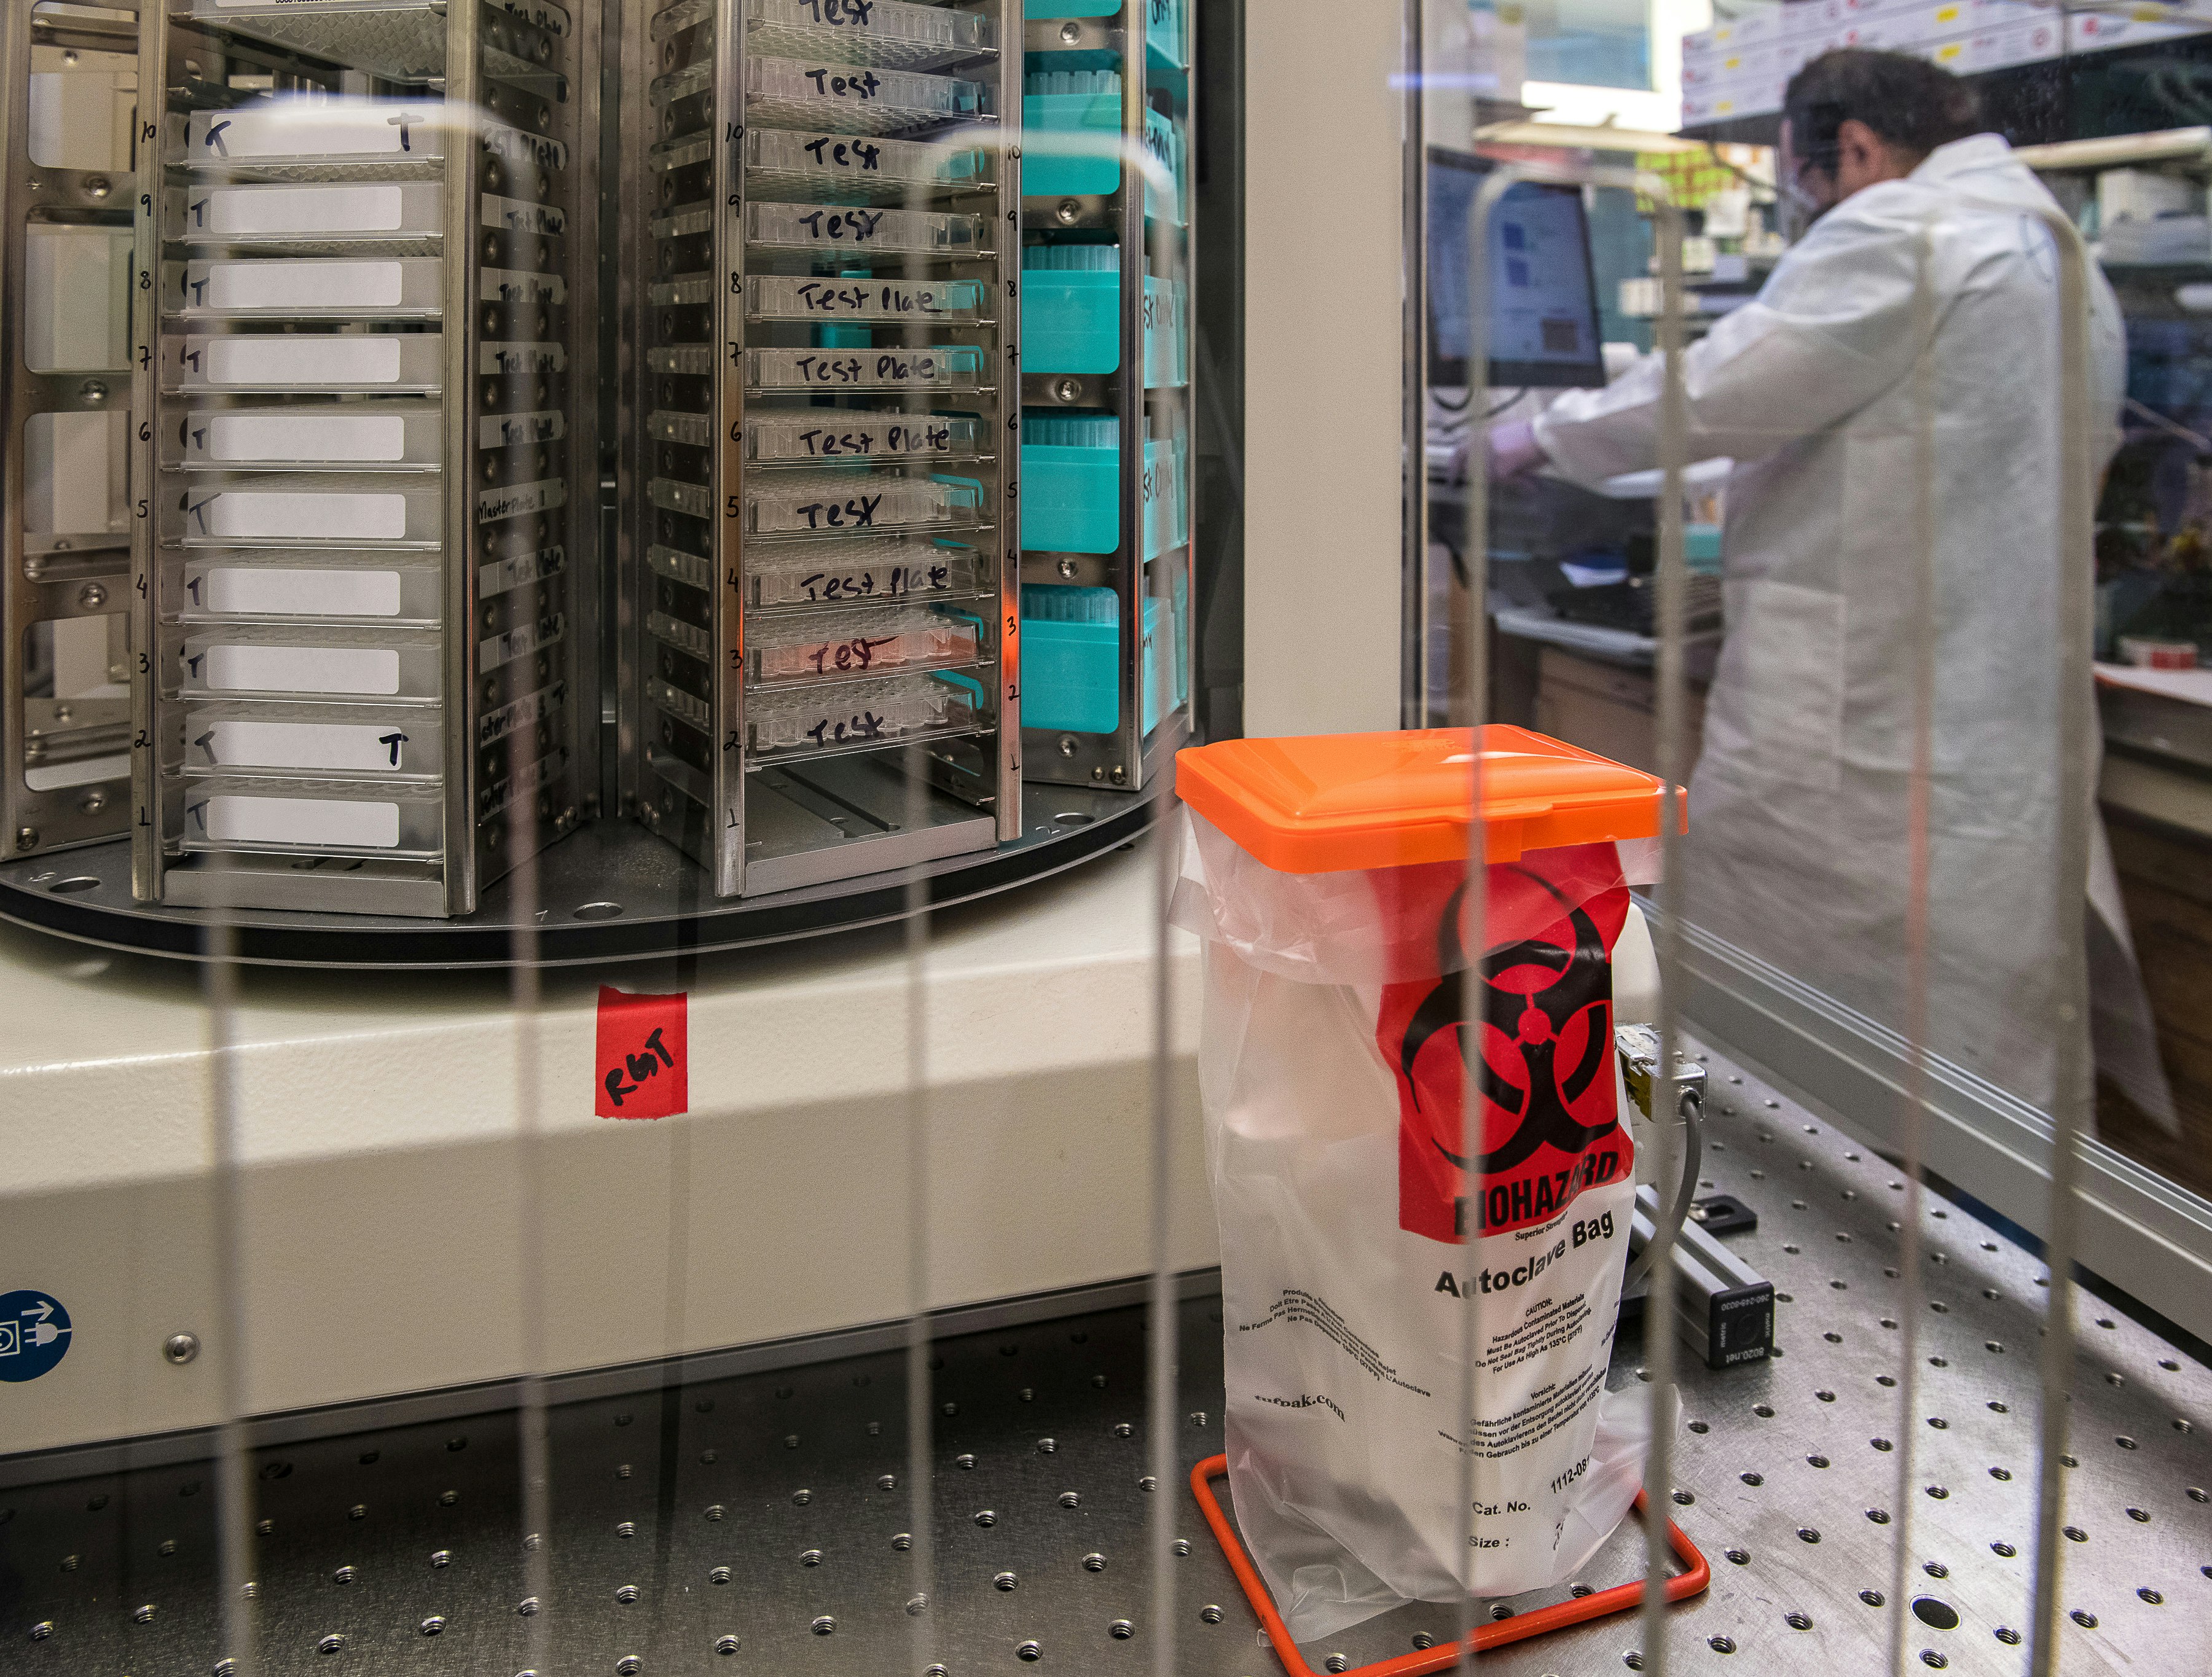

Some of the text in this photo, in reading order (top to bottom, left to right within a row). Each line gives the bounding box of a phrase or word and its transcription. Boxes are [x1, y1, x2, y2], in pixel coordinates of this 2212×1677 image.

[805, 68, 880, 99] Test
[141, 121, 157, 143] 10
[387, 113, 424, 152] T
[726, 122, 743, 143] 10
[804, 137, 880, 170] Test
[1008, 144, 1021, 161] 10
[141, 194, 151, 217] 9
[190, 198, 208, 227] T
[728, 194, 741, 218] 9
[799, 210, 883, 241] Test
[1008, 210, 1017, 232] 9
[141, 270, 151, 289] 8
[731, 271, 742, 294] 8
[1007, 280, 1016, 297] 8
[190, 278, 210, 307] T
[798, 283, 943, 313] Test Plate
[138, 345, 152, 371] 7
[186, 350, 201, 373] T
[728, 341, 742, 367] 7
[1006, 344, 1019, 366] 7
[796, 354, 935, 382] Test Plate
[139, 421, 151, 441] 6
[730, 421, 742, 442] 6
[1008, 413, 1018, 430] 6
[192, 428, 206, 450] T
[800, 425, 949, 455] Test Plate
[1006, 482, 1018, 498] 5
[136, 499, 148, 518] 5
[189, 493, 222, 535] T
[726, 496, 739, 518] 5
[797, 493, 882, 528] Test
[1007, 549, 1017, 569] 4
[136, 574, 147, 600] 4
[187, 576, 202, 606] T
[727, 568, 739, 593] 4
[801, 566, 947, 601] Test Plate
[1007, 616, 1016, 636] 3
[139, 652, 150, 673] 3
[187, 653, 203, 678] T
[729, 649, 742, 669] 3
[809, 635, 900, 674] Test
[1008, 684, 1021, 701] 2
[135, 730, 151, 748] 2
[723, 730, 742, 751] 2
[807, 711, 884, 747] Test
[194, 730, 409, 766] T T
[1010, 754, 1020, 771] 1
[139, 806, 151, 826] 1
[187, 799, 211, 831] T
[727, 808, 740, 829] 1
[1515, 1228, 1545, 1241] Superior
[1572, 1210, 1615, 1249] Bag
[1492, 1327, 1523, 1343] Hazardous
[1524, 1307, 1561, 1329] Contaminated
[1562, 1293, 1585, 1310] Materials
[1526, 1298, 1553, 1318] CAUTION:
[1269, 1302, 1282, 1312] Doit
[1378, 1361, 1396, 1375] Rejet
[1487, 1347, 1502, 1356] Must
[1513, 1328, 1544, 1347] Autoclaved
[1545, 1321, 1558, 1332] Prior
[1500, 1352, 1513, 1362] Seal
[1514, 1347, 1526, 1356] Bag
[1528, 1335, 1545, 1350] Tightly
[1546, 1326, 1565, 1340] During
[1252, 1317, 1273, 1330] Ferme
[1274, 1310, 1285, 1319] Pas
[1386, 1374, 1430, 1397] L'Autoclave
[1493, 1365, 1503, 1374] For
[1504, 1360, 1516, 1369] Use
[1526, 1349, 1539, 1361] High
[1549, 1337, 1566, 1350] 135°C
[1254, 1394, 1346, 1422] tufpak.com
[1471, 1416, 1512, 1427] Gefährliche
[1513, 1396, 1552, 1420] kontaminierte
[1553, 1378, 1577, 1400] Materialien
[1511, 1422, 1521, 1431] der
[1522, 1405, 1555, 1426] Entsorgung
[1555, 1385, 1582, 1409] autoklaviert
[1486, 1445, 1520, 1458] Gebrauch
[1540, 1428, 1553, 1439] einer
[1553, 1407, 1579, 1431] Temperatur
[1488, 1427, 1535, 1448] Autoklavierens
[1536, 1421, 1547, 1431] den
[1547, 1411, 1563, 1424] Beutel
[1564, 1401, 1576, 1413] nicht
[1472, 1501, 1531, 1515] Cat. No.
[1469, 1536, 1500, 1548] Size
